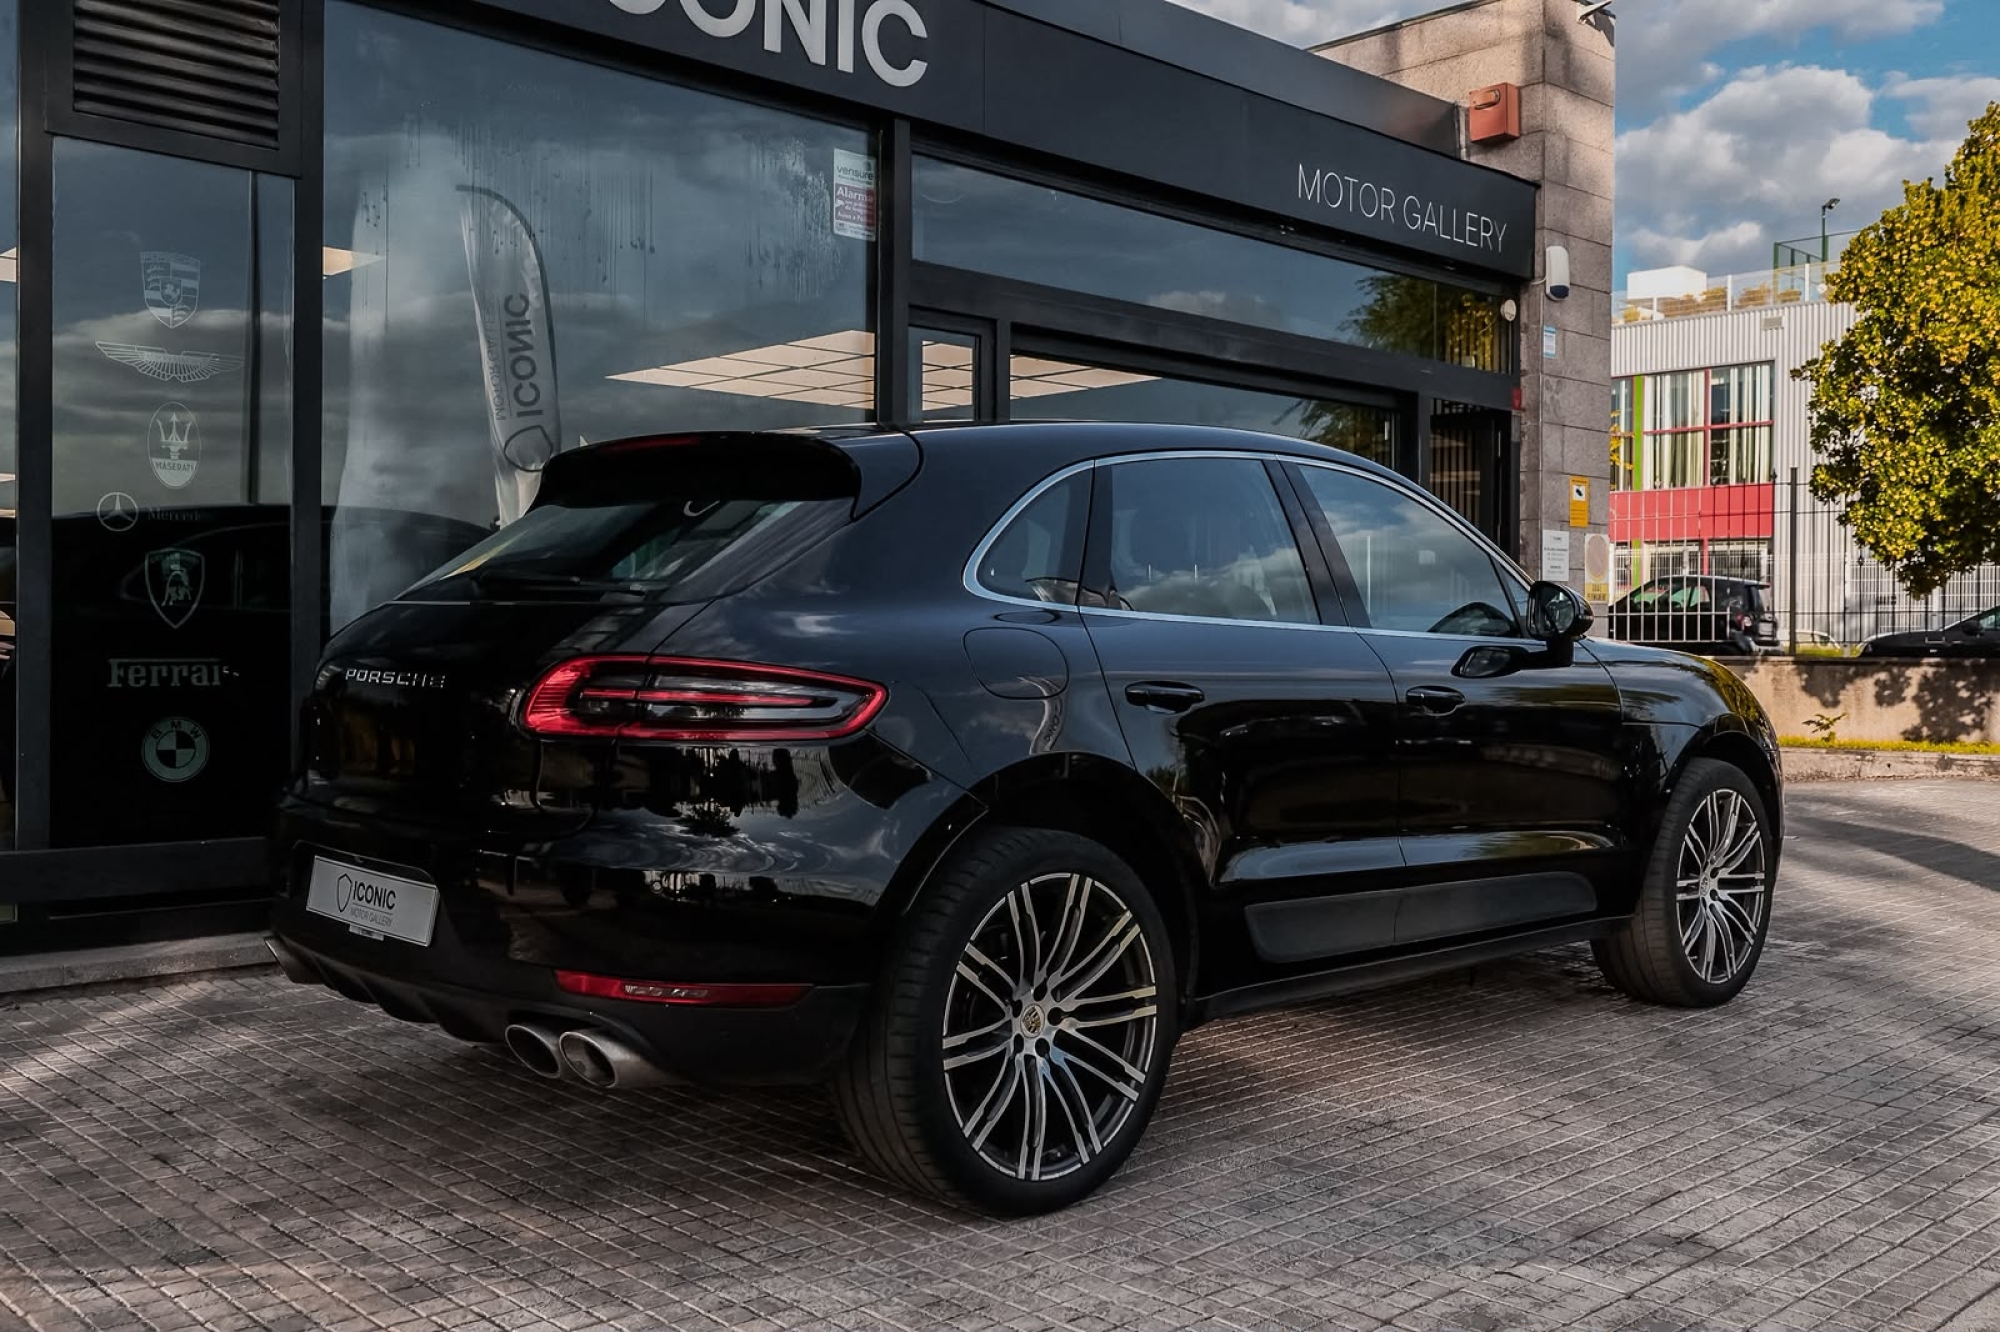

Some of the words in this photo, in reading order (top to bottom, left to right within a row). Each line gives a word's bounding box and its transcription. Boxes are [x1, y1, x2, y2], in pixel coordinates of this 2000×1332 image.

[1298, 163, 1396, 224] MOTOR
[1403, 195, 1507, 253] GALLERY
[155, 461, 195, 472] MASERATI
[147, 507, 209, 521] Merced
[107, 658, 222, 688] Ferra
[150, 719, 202, 741] BMW
[353, 881, 396, 910] ICONIC
